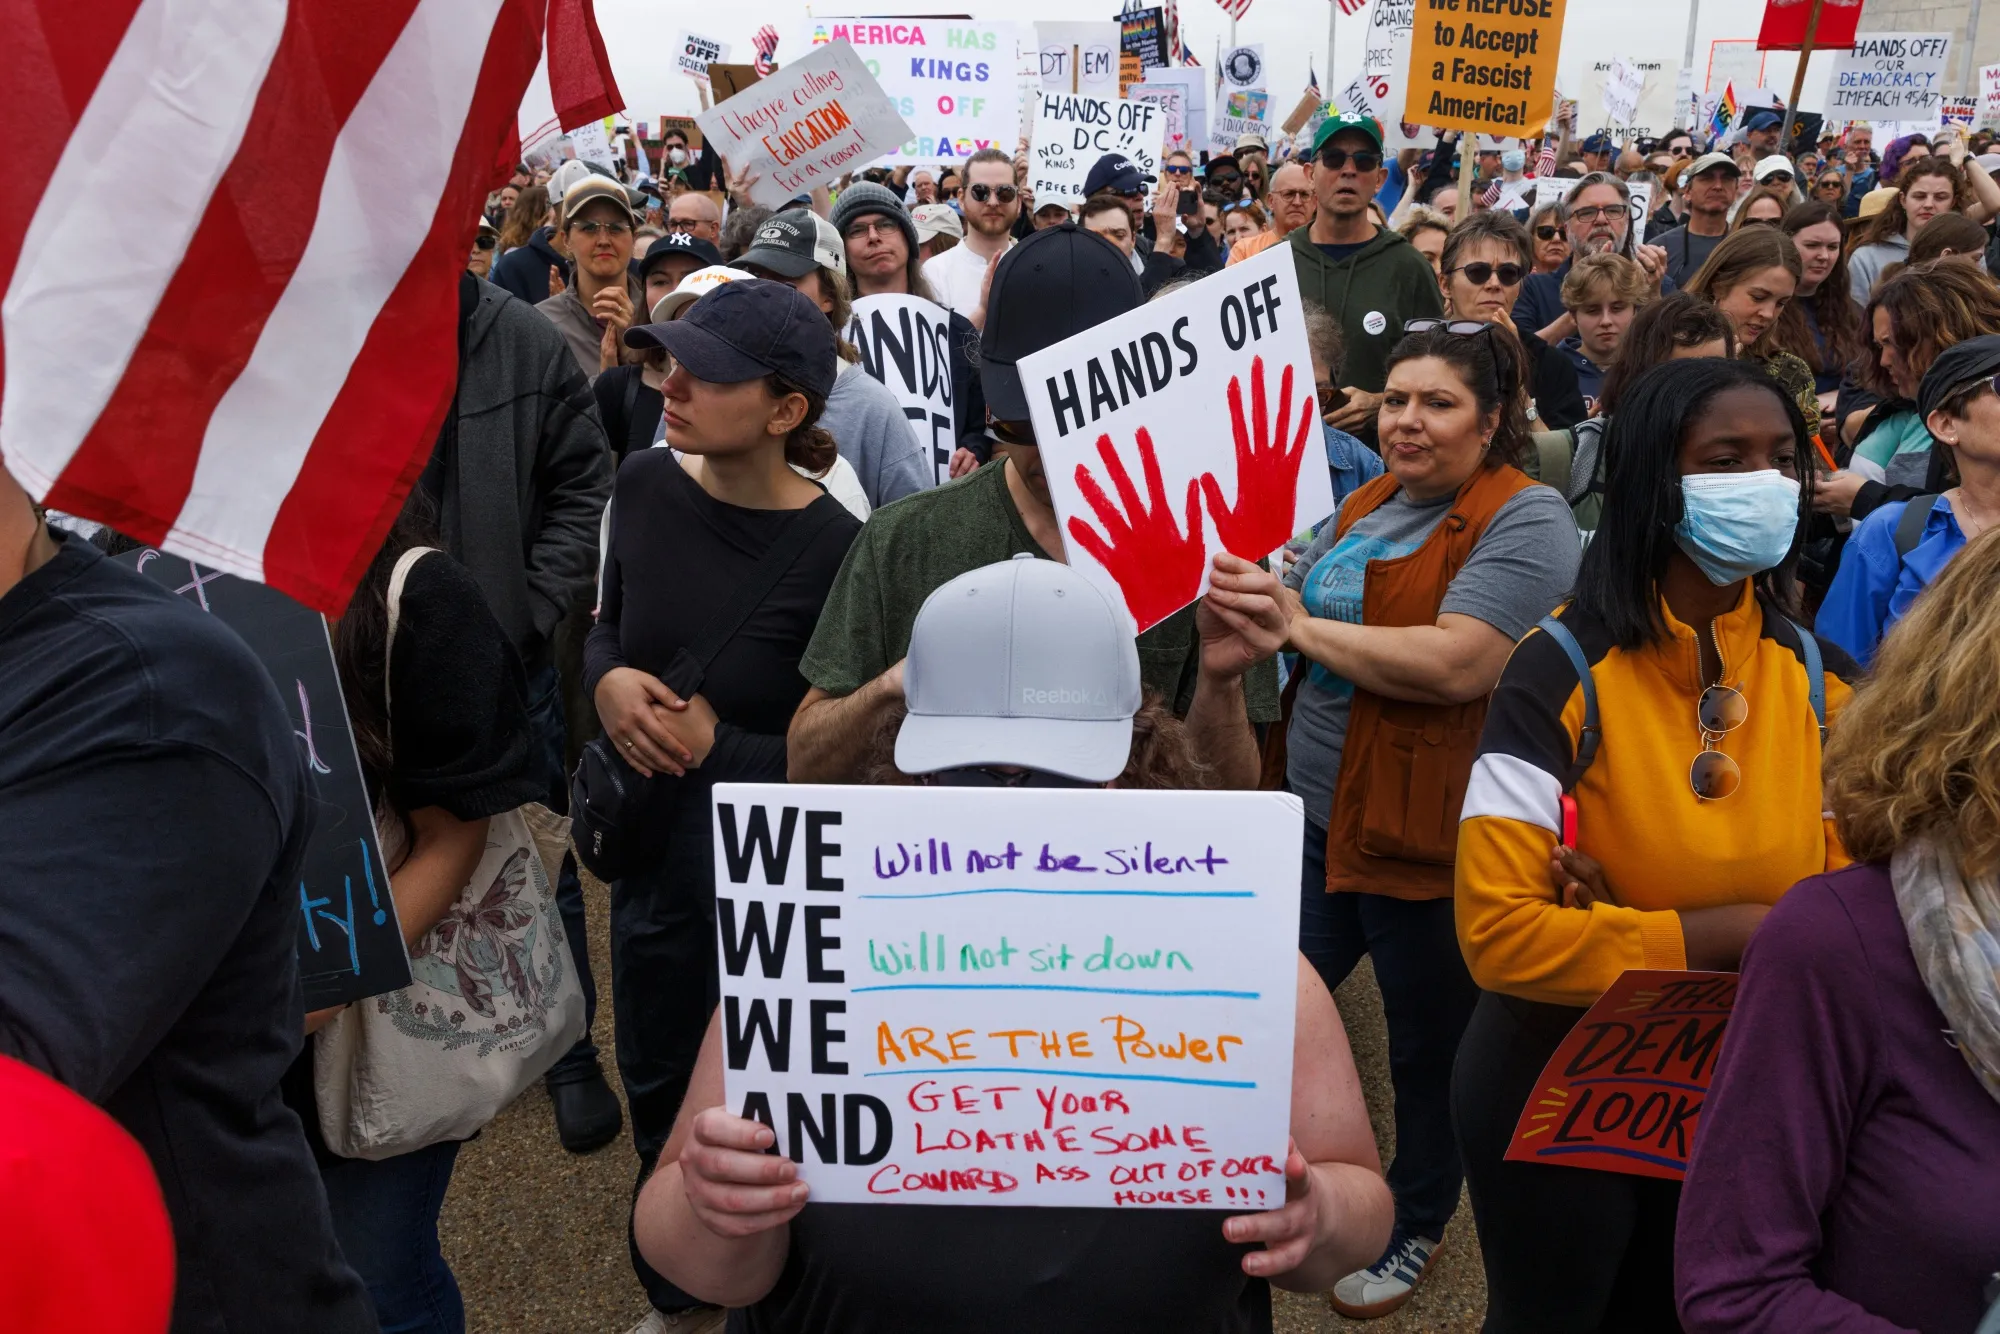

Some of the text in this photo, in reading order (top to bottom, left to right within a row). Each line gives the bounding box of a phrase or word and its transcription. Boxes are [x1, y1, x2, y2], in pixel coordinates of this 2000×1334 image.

[1375, 9, 1415, 27] CHANG
[1466, 0, 1552, 18] REFUSE
[1120, 9, 1157, 42] NO!
[688, 35, 720, 52] HANDS
[812, 24, 996, 51] AMERICA HAS
[1434, 21, 1538, 58] to Accept
[1851, 39, 1948, 58] HANDS OFF!
[685, 44, 719, 64] OFF!
[1040, 52, 1066, 75] DT
[1085, 52, 1108, 74] EM
[1140, 50, 1159, 59] EFUSE
[1875, 60, 1905, 71] OUR
[911, 57, 989, 82] KINGS
[1432, 58, 1532, 90] a Fascist
[1839, 72, 1936, 87] DEMOCRACY
[937, 95, 986, 118] OFF
[1428, 91, 1527, 126] America!
[1832, 90, 1900, 107] IMPEACH
[1904, 89, 1939, 108] 45/47
[1044, 94, 1111, 126] HANDS
[1118, 103, 1155, 132] OFF
[1222, 117, 1271, 137] IDIOCRACY
[1615, 127, 1650, 137] MICE?
[806, 162, 821, 177] a
[821, 128, 866, 169] reason!
[1038, 143, 1064, 158] NO
[1134, 148, 1153, 168] NO
[1045, 157, 1075, 170] KINGS
[756, 221, 801, 237] CHARLESTON
[764, 238, 790, 248] CAROLINA
[848, 307, 952, 407] ANDS
[1046, 274, 1281, 438] HANDS OFF
[1022, 686, 1091, 704] Reebok
[717, 803, 844, 891] WE
[874, 838, 952, 879] Will
[966, 842, 1023, 873] not
[1034, 843, 1098, 873] be
[717, 897, 845, 983] WE
[960, 936, 1018, 972] not
[1029, 943, 1075, 972] sit
[1084, 935, 1194, 972] down
[724, 995, 1243, 1075] WE ARE THE Power
[1564, 1017, 1728, 1081] DEM
[908, 1081, 1021, 1114] GET
[740, 1092, 893, 1166] AND
[915, 1122, 1212, 1154] LOATHESOME
[867, 1155, 1283, 1194] COWARD ASS OUT OF OUR
[1114, 1188, 1212, 1206] HOUSE
